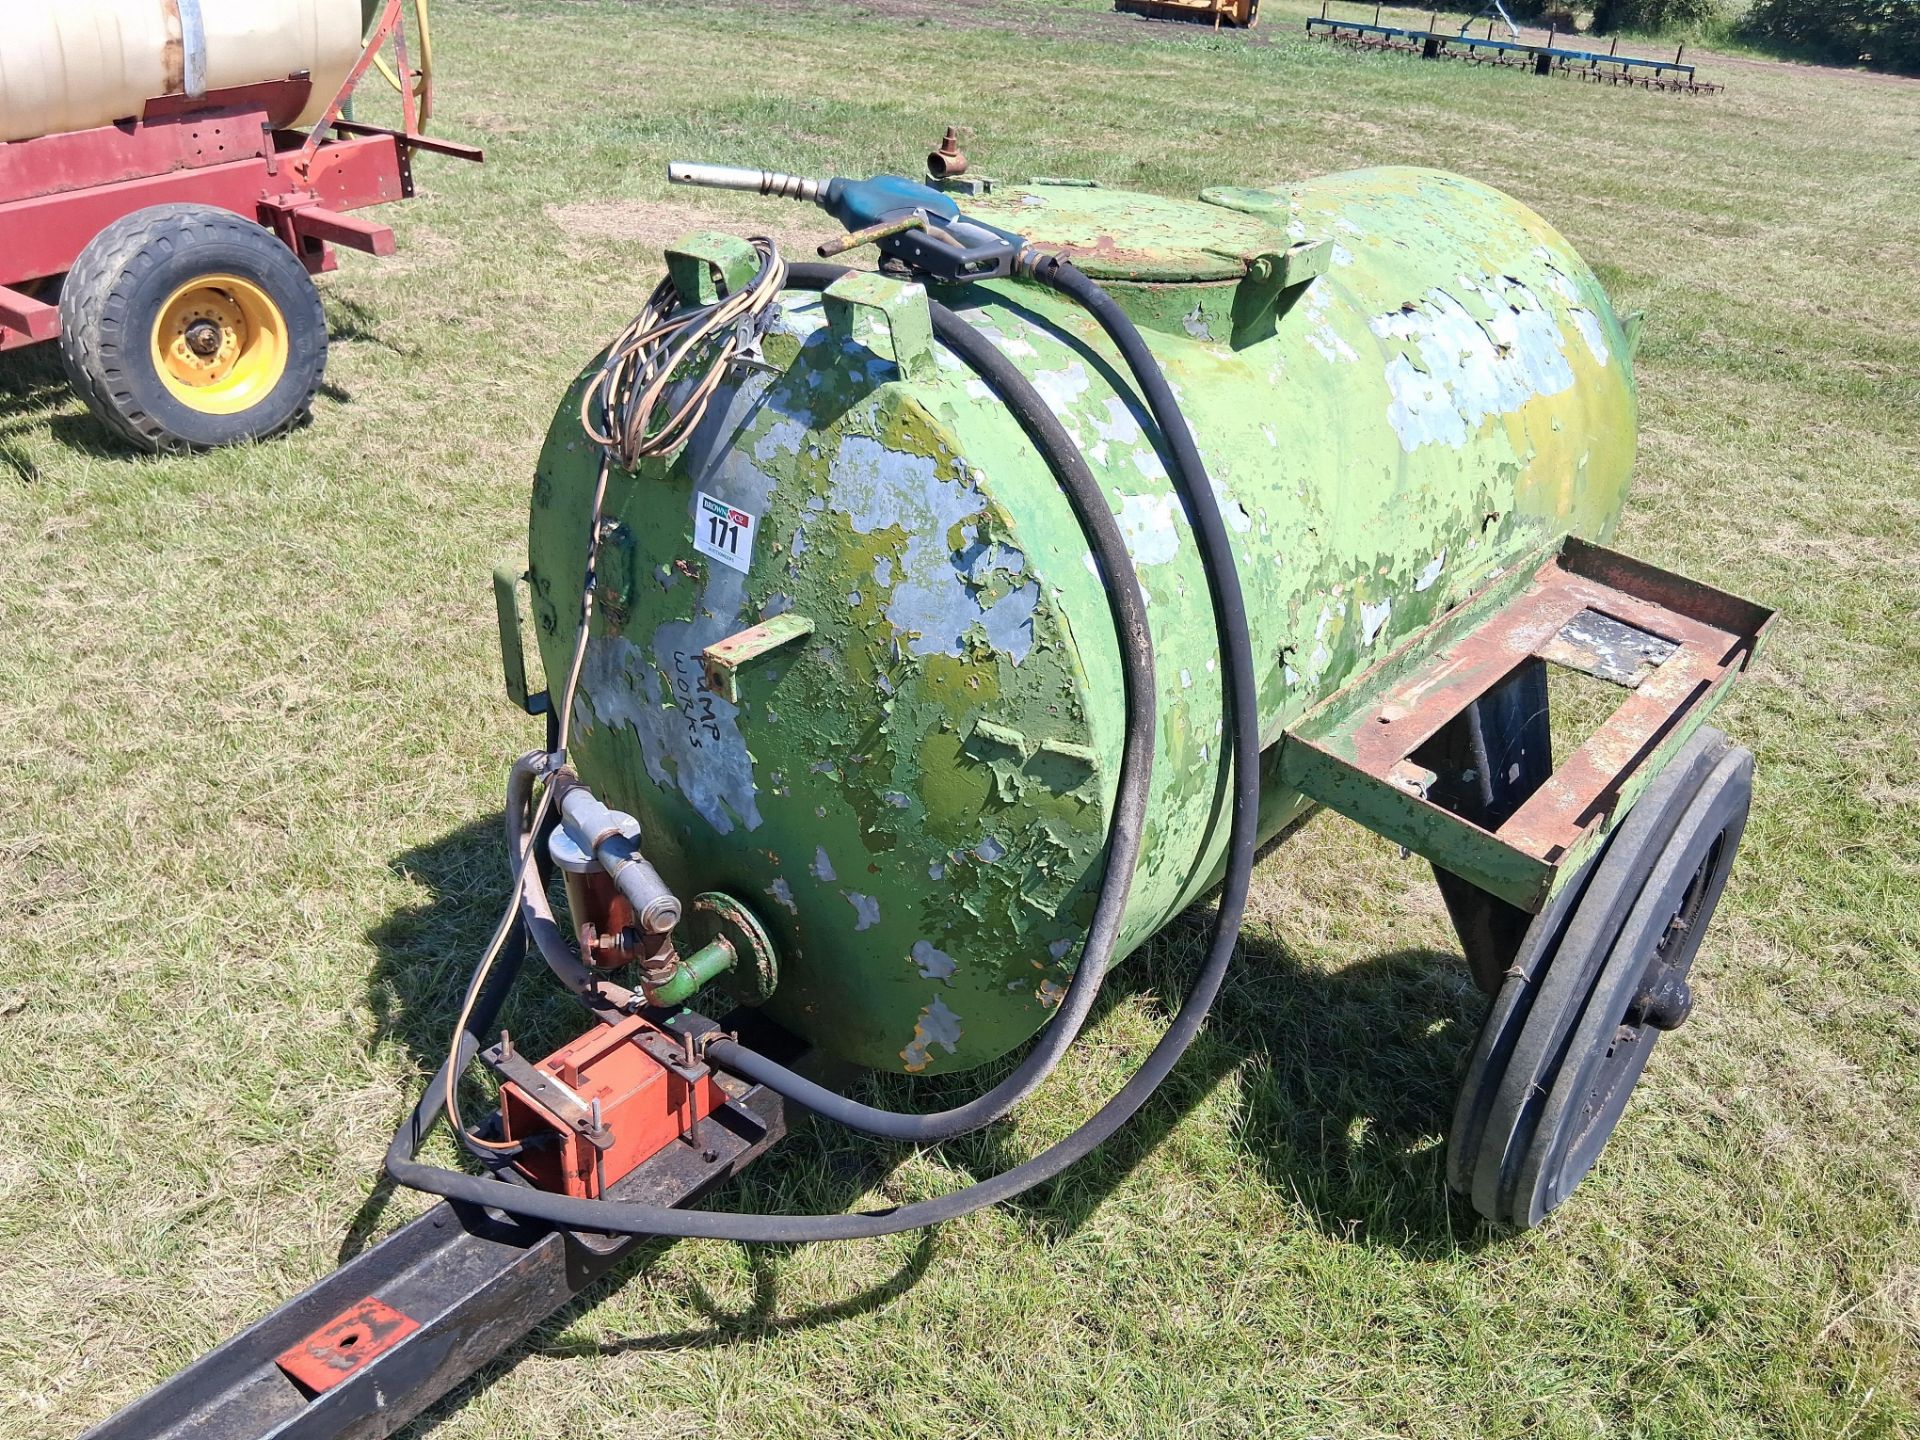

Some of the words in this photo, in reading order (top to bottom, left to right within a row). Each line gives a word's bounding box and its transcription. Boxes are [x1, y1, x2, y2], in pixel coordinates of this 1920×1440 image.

[708, 516, 739, 554] 171
[673, 651, 703, 749] WORKS
[690, 655, 721, 741] PUMP
